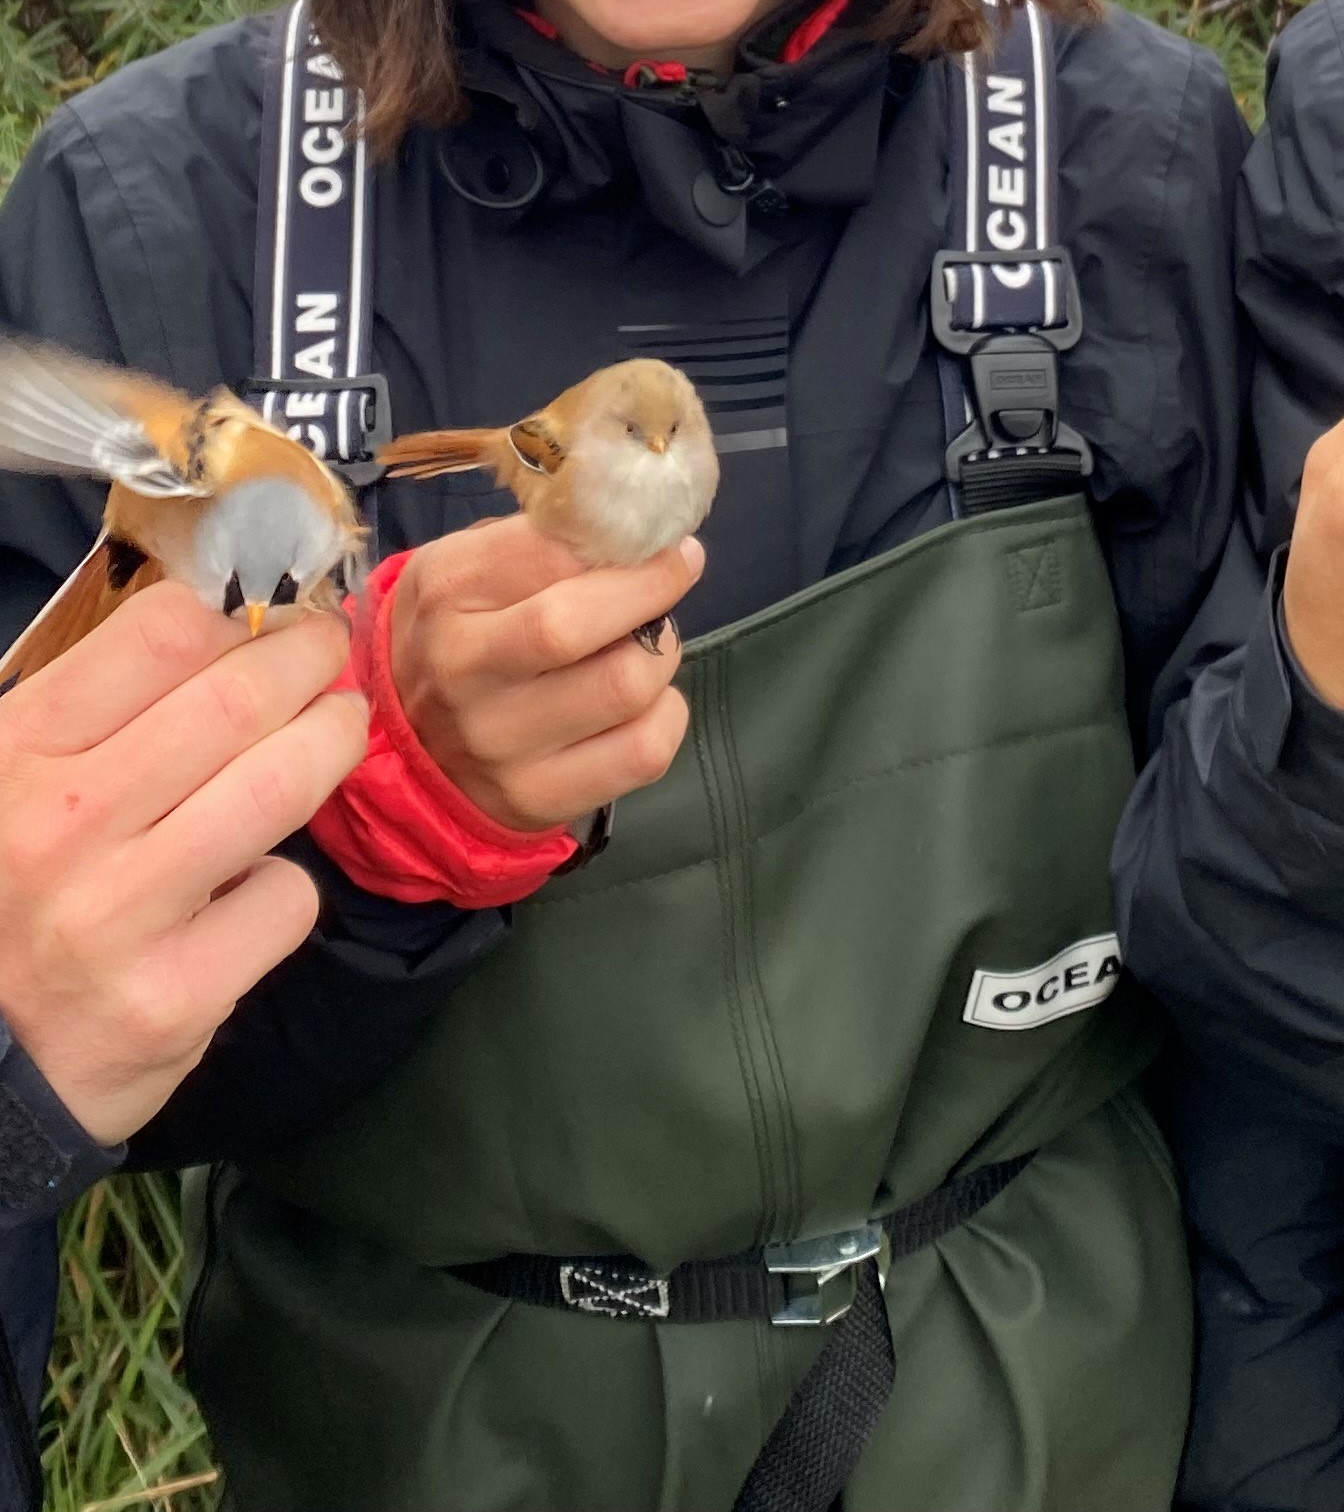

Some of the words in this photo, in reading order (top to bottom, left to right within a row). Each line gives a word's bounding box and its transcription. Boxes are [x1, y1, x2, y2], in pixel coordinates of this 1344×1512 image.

[299, 23, 346, 209] OCEA
[286, 292, 340, 460] CEAN
[991, 954, 1121, 1012] OCEA
